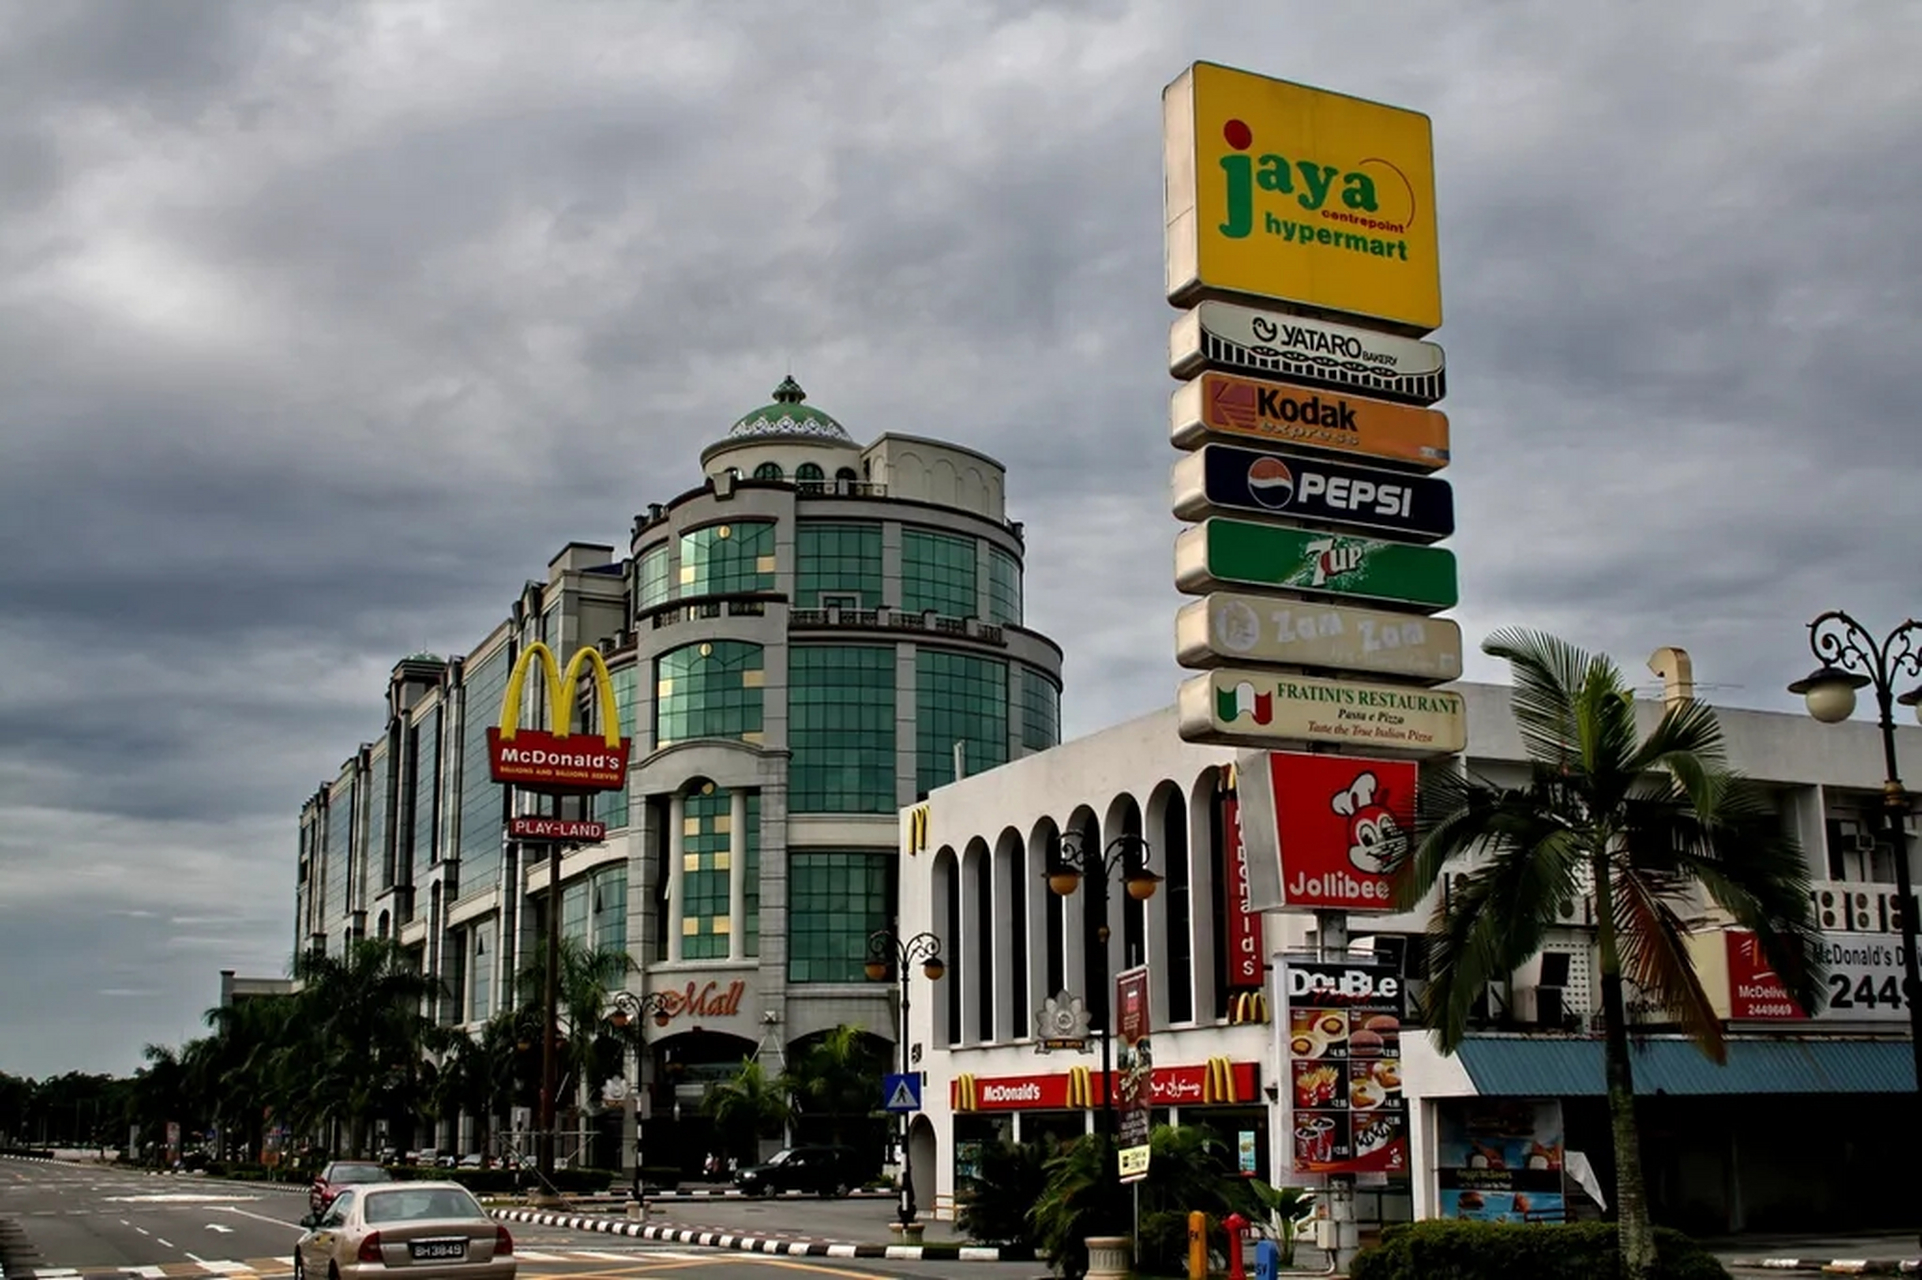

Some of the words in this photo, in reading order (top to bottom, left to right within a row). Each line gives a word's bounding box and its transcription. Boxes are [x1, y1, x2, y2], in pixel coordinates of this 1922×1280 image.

[1218, 119, 1379, 239] jaya
[1321, 208, 1405, 234] centrepoint
[1264, 212, 1408, 261] hypermart
[1281, 324, 1362, 359] YATARO
[1362, 351, 1398, 366] BAKERY
[1257, 387, 1358, 432] Kodak
[1298, 472, 1413, 518] PEPSI
[1277, 683, 1355, 703] FRATINI'S
[1358, 690, 1460, 715] RESTAURANT
[1308, 720, 1332, 733] Taste
[1333, 722, 1350, 735] the
[1352, 725, 1373, 737] True
[1374, 726, 1407, 740] Italian
[1337, 708, 1367, 722] Pasta
[501, 748, 620, 770] McDonald's
[514, 821, 602, 838] PLAY-LAND
[1289, 871, 1390, 899] Jollibee
[668, 980, 745, 1018] Mall
[983, 1082, 1041, 1102] McDonald's
